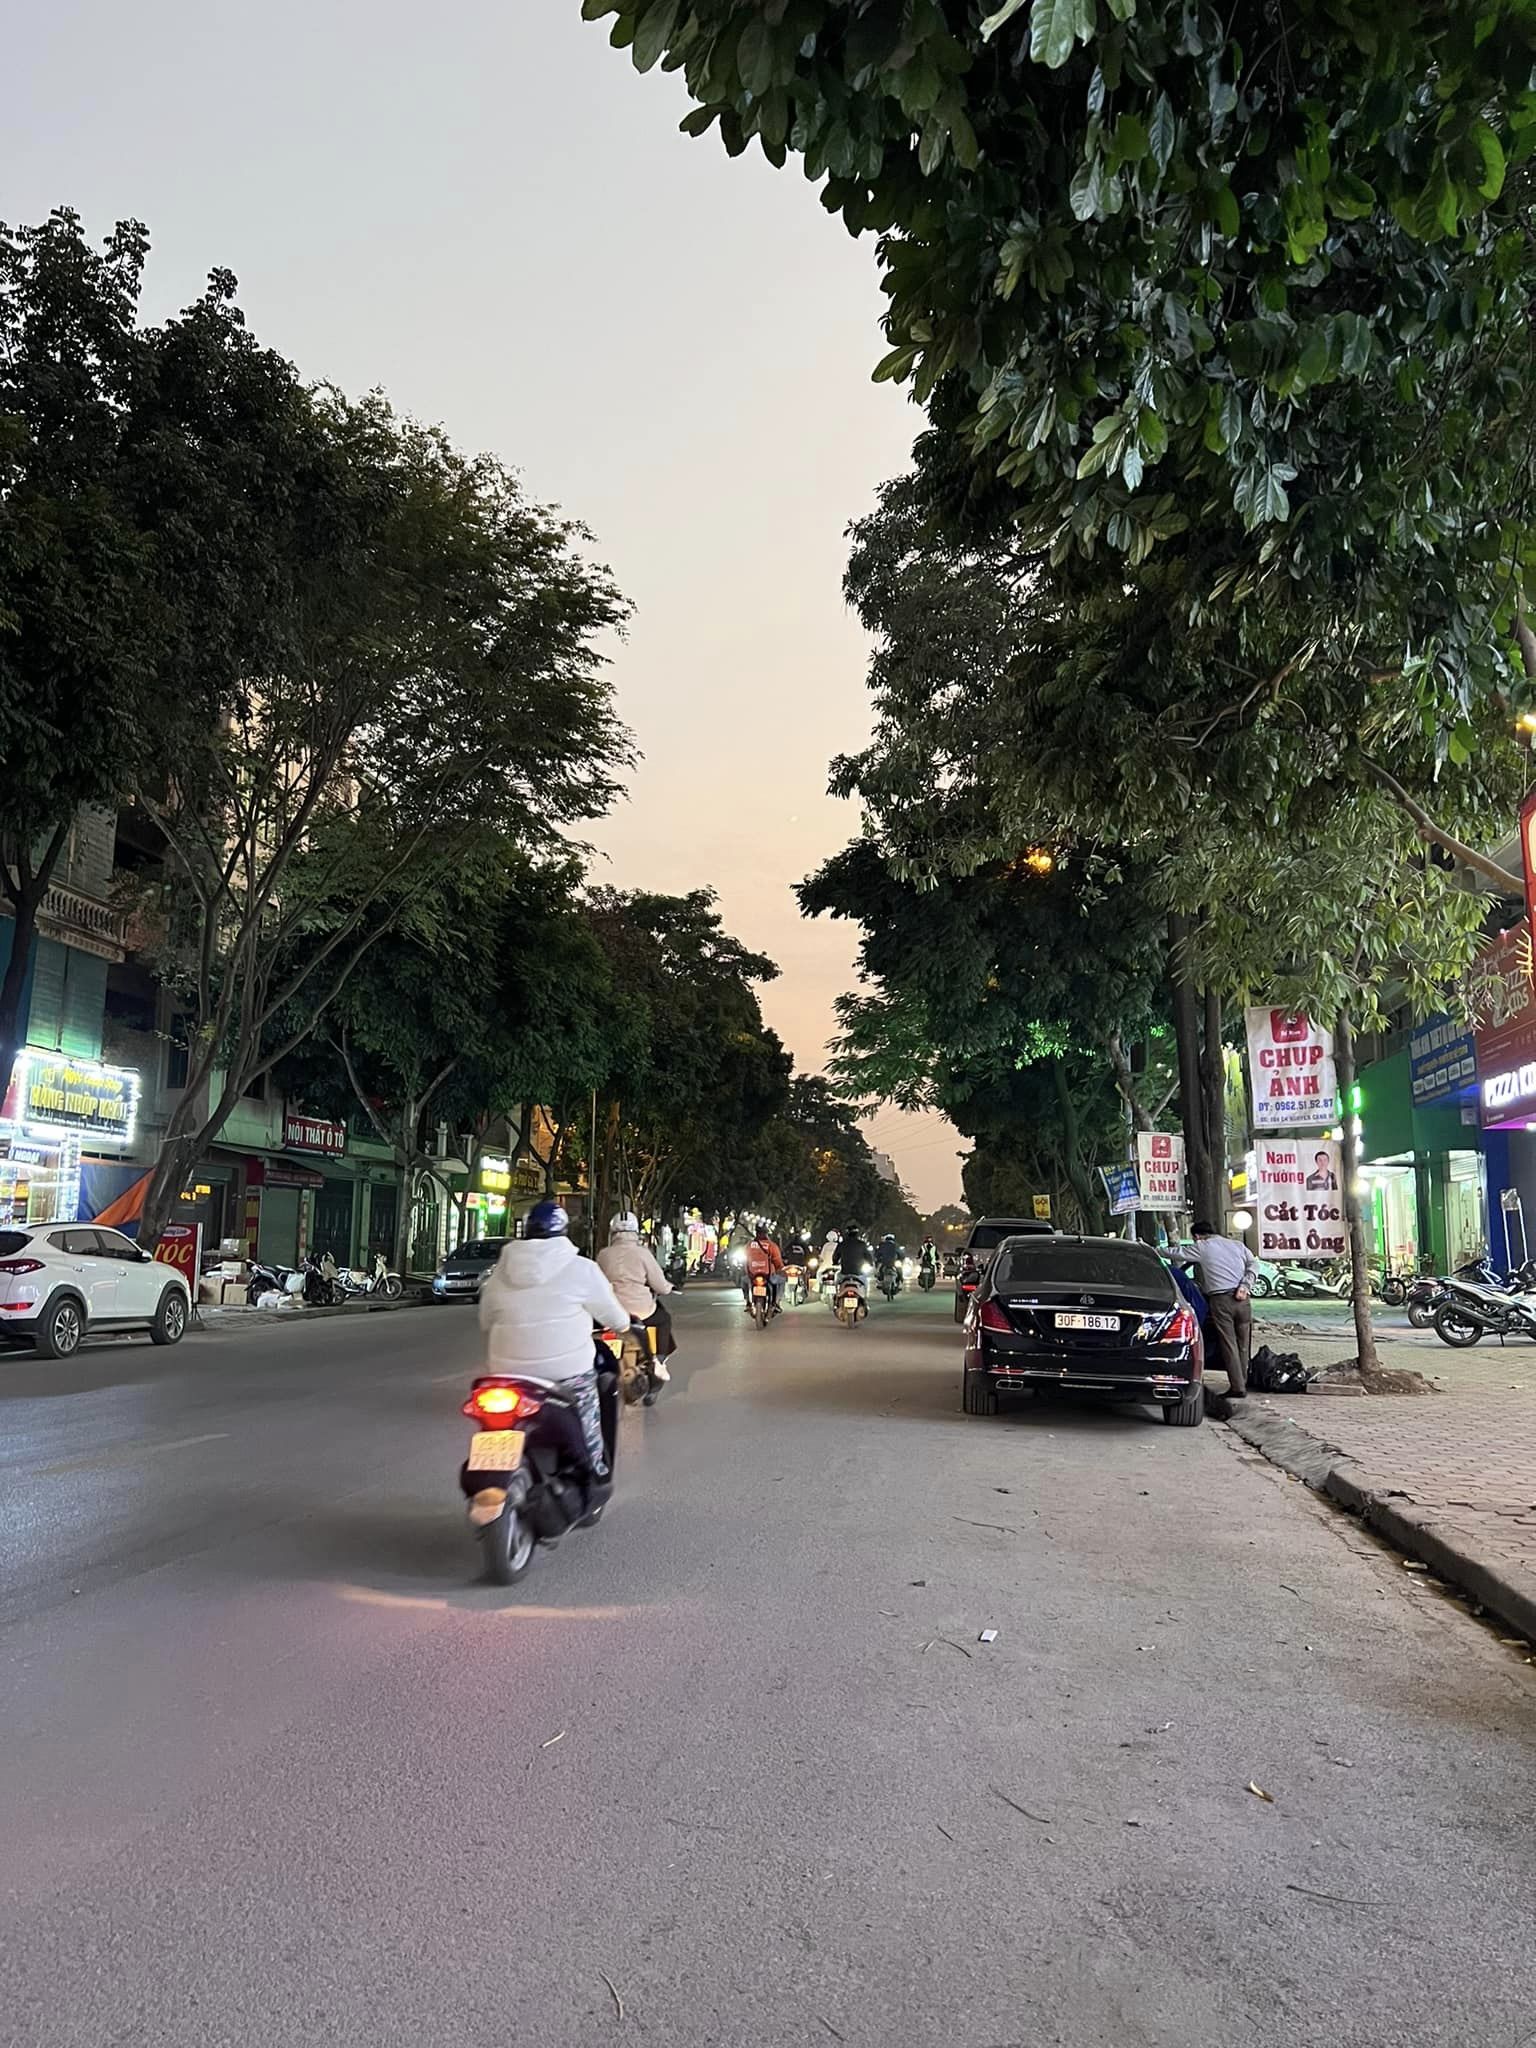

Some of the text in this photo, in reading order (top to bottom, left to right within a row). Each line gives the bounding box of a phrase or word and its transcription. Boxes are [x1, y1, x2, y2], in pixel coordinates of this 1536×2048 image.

[1259, 1045, 1324, 1071] CHỤP
[1269, 1069, 1320, 1097] ẢNH
[1484, 1071, 1520, 1108] PIZZA
[287, 1122, 345, 1148] NỘI THẤT Ô TÔ
[1266, 1151, 1296, 1164] Nam
[1264, 1201, 1340, 1221] Cắt Tóc
[1262, 1228, 1346, 1253] Đàn Ông
